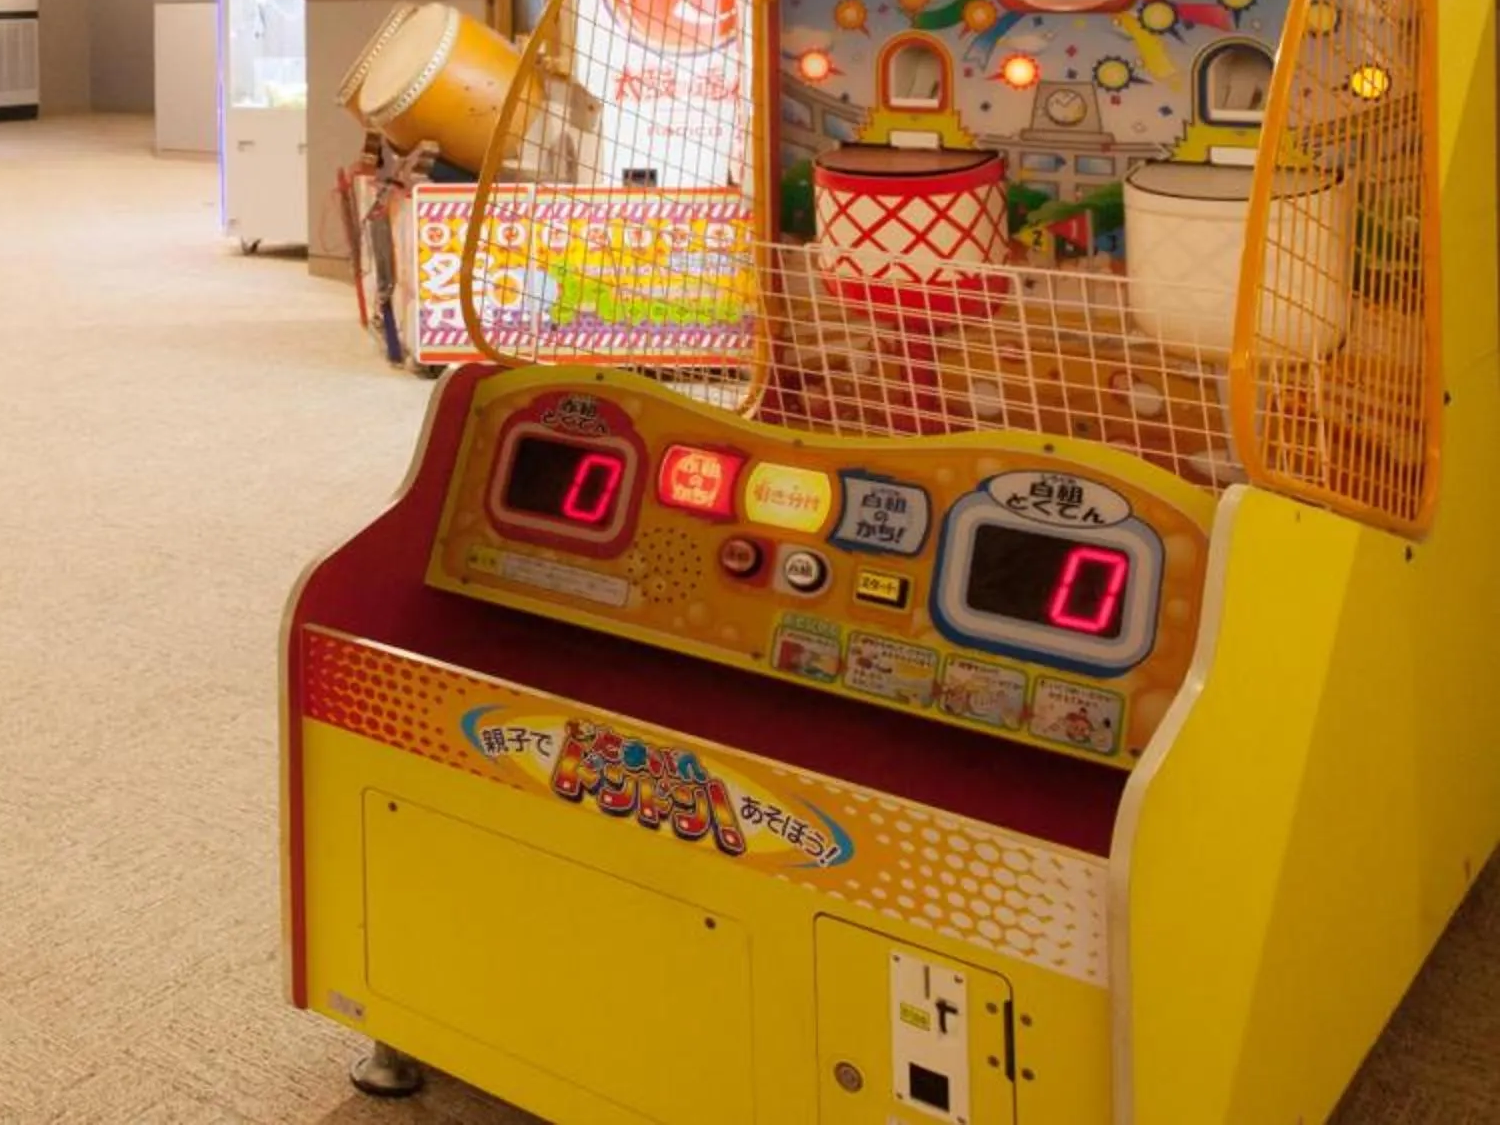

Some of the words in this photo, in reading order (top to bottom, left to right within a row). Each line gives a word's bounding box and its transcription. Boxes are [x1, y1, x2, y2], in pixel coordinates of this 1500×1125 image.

[562, 454, 623, 523] 0
[861, 491, 907, 514] 白組
[1029, 481, 1084, 504] 白組
[874, 509, 889, 523] の
[1005, 493, 1105, 524] とくてん
[1051, 546, 1129, 633] 0
[481, 727, 555, 757] 親子で
[741, 794, 841, 868] あそぼう!
